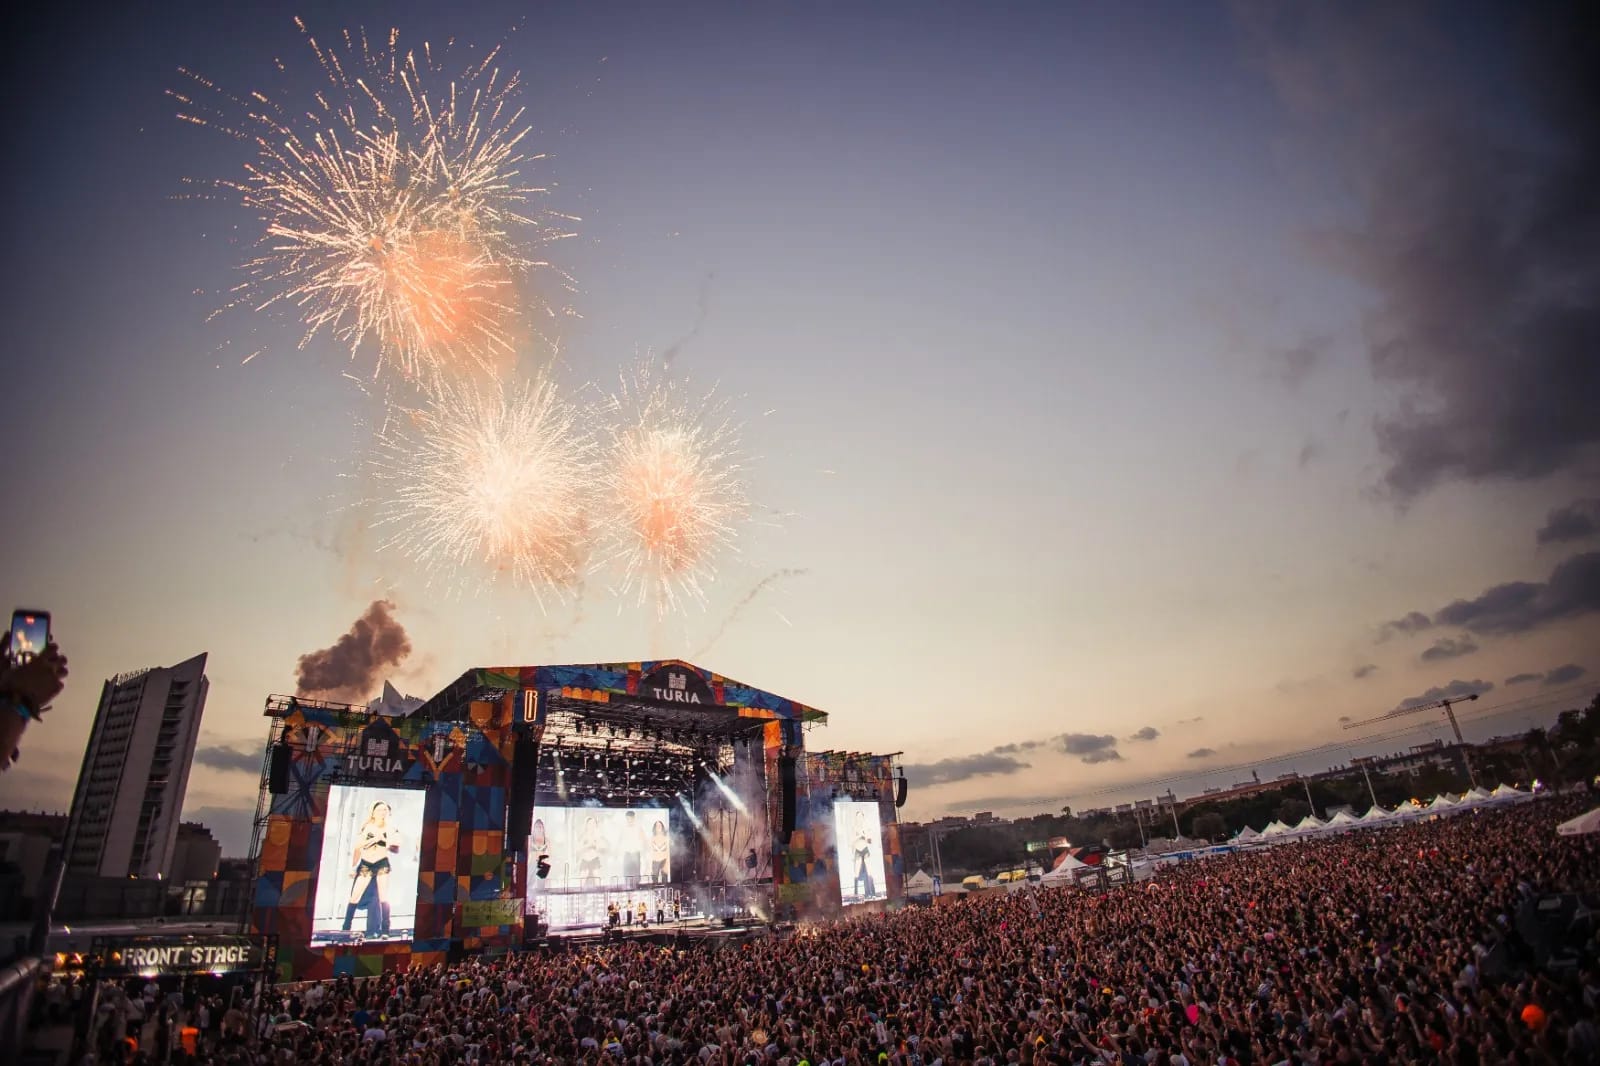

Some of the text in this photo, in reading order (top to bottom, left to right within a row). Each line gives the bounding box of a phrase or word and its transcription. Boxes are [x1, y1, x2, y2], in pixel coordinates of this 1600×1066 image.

[653, 687, 701, 704] TURIA
[346, 755, 403, 772] TURIA
[120, 946, 251, 966] FRONT STAGE
